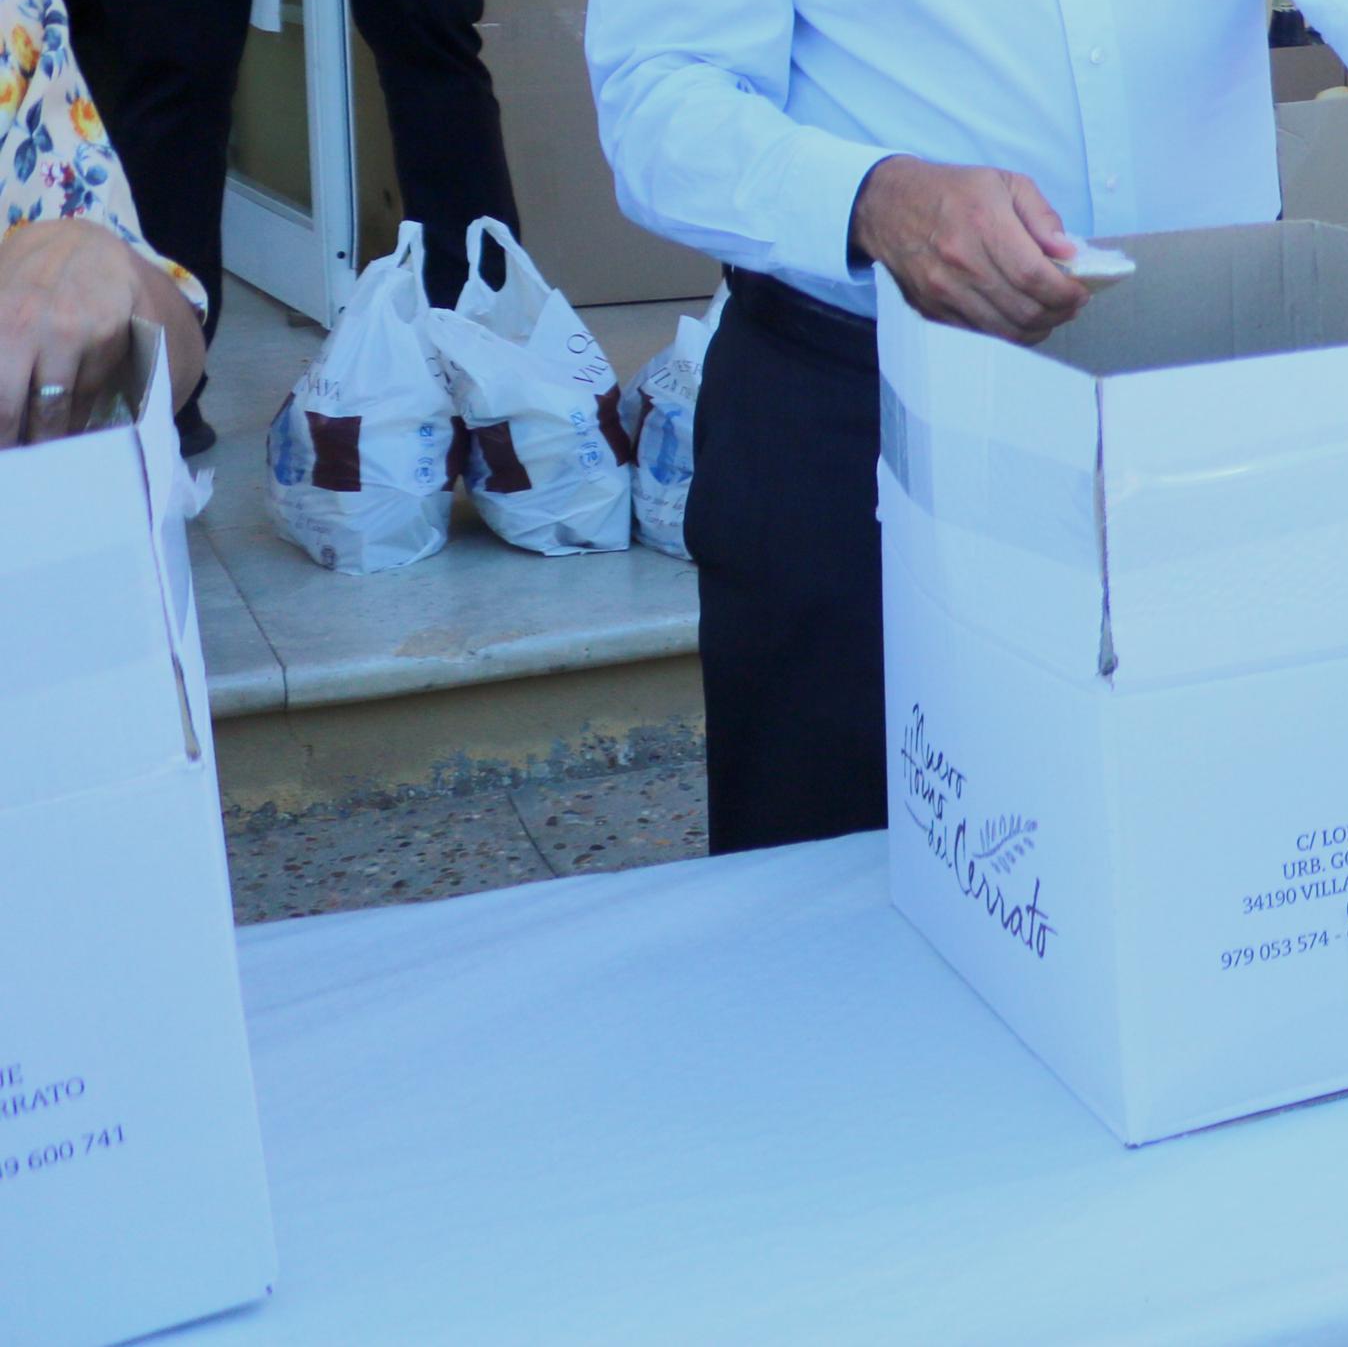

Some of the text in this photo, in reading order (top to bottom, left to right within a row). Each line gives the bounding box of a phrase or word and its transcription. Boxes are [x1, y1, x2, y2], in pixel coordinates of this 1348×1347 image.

[901, 724, 948, 821] Horno
[911, 702, 967, 800] Nuevo
[1296, 830, 1317, 852] C/
[955, 817, 1058, 958] Cerrato
[1283, 857, 1326, 880] URB.
[1242, 887, 1297, 914] 34190
[1221, 947, 1254, 971] 979
[1259, 938, 1292, 962] 053
[1297, 929, 1329, 953] 574
[28, 1141, 74, 1170] 600
[82, 1124, 125, 1154] 741
